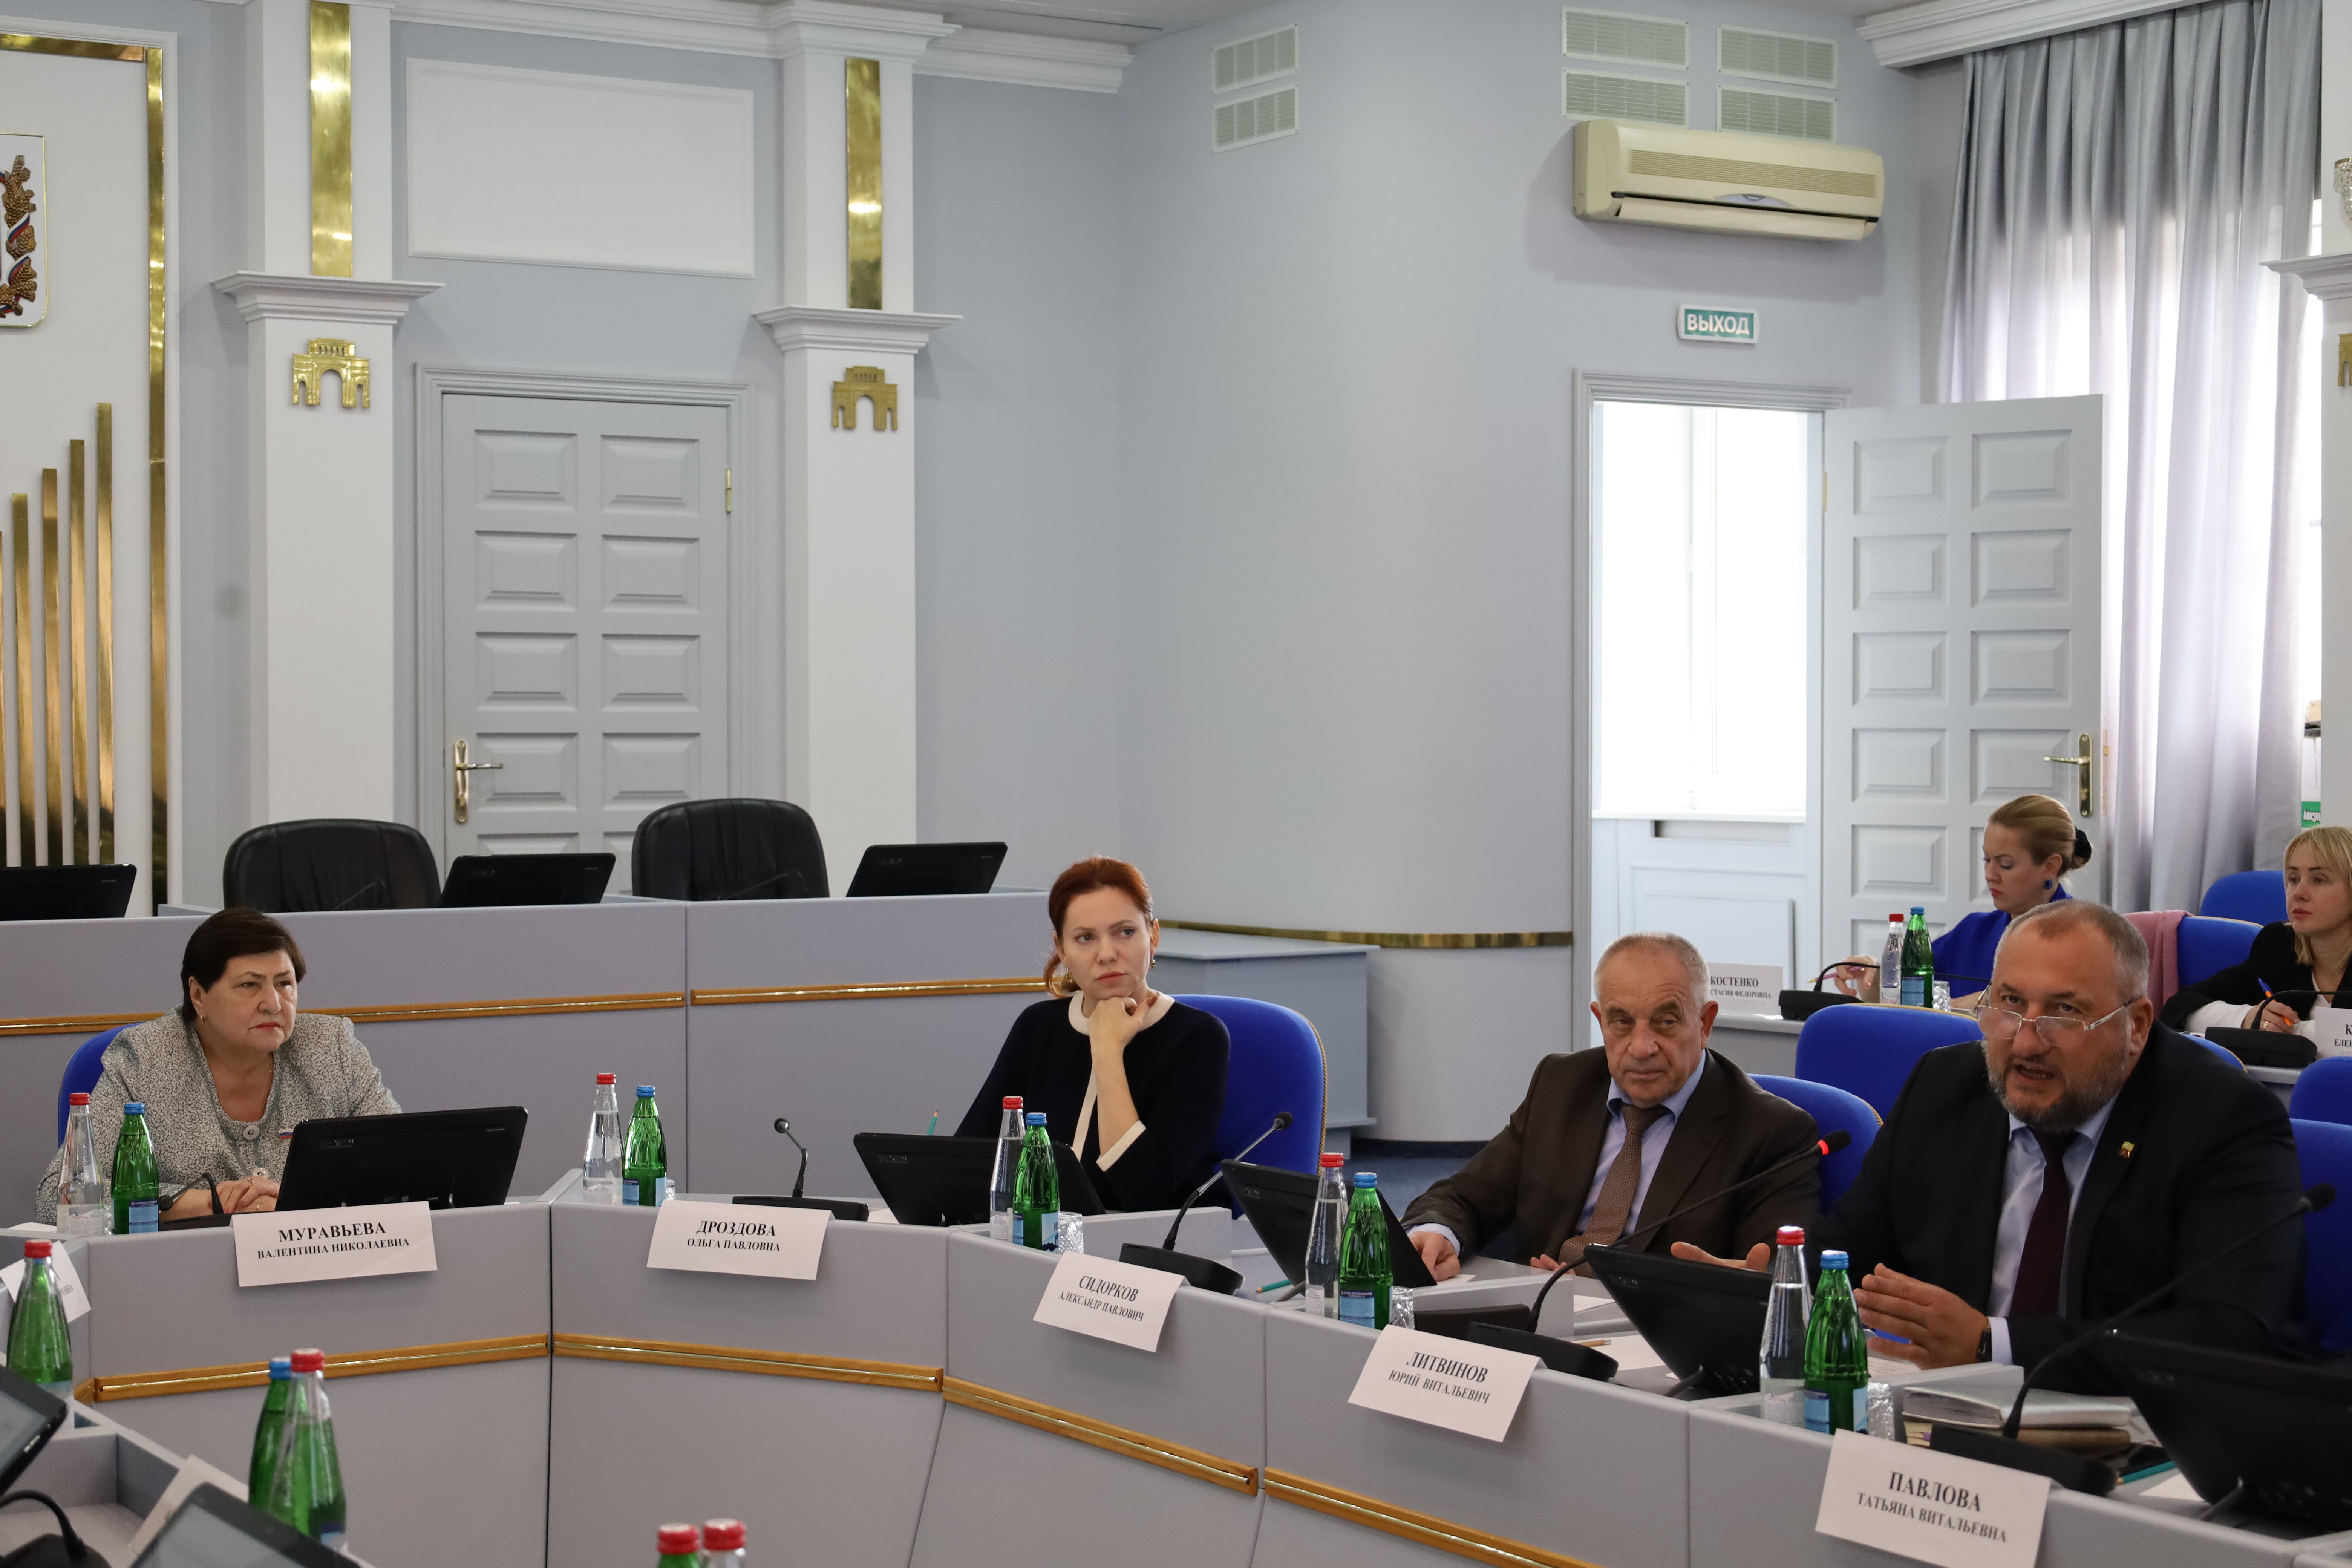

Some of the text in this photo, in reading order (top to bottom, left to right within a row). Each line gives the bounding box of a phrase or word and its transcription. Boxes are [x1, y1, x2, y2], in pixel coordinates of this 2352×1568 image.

[1687, 314, 1750, 335] ВЫХОД
[1710, 975, 1759, 988] КОСТЕНКО
[1735, 990, 1772, 998] ФЕДОРОВНА
[278, 1222, 386, 1242] МУРАВЬЕВА
[696, 1220, 776, 1237] ДРОЗДОВА
[257, 1238, 410, 1259] ВАЛЕНТИНА НИКОЛАЕВНА
[687, 1238, 780, 1251] ОЛЬГА ПАВЛОВНА
[1079, 1275, 1139, 1302] СИДОРКОВ
[1058, 1291, 1144, 1322] АЛЕКСАНДР ПАВЛОВИЧ
[1406, 1352, 1488, 1383] ЛИТВИНОВ
[1388, 1370, 1491, 1404] ЮРИЙ ВИТАЛЬЕВИЧ
[1889, 1471, 1981, 1512] ПАВЛОВА
[1857, 1492, 2006, 1542] ТАТЬЯНА ВИТАЛЬЕВНА
